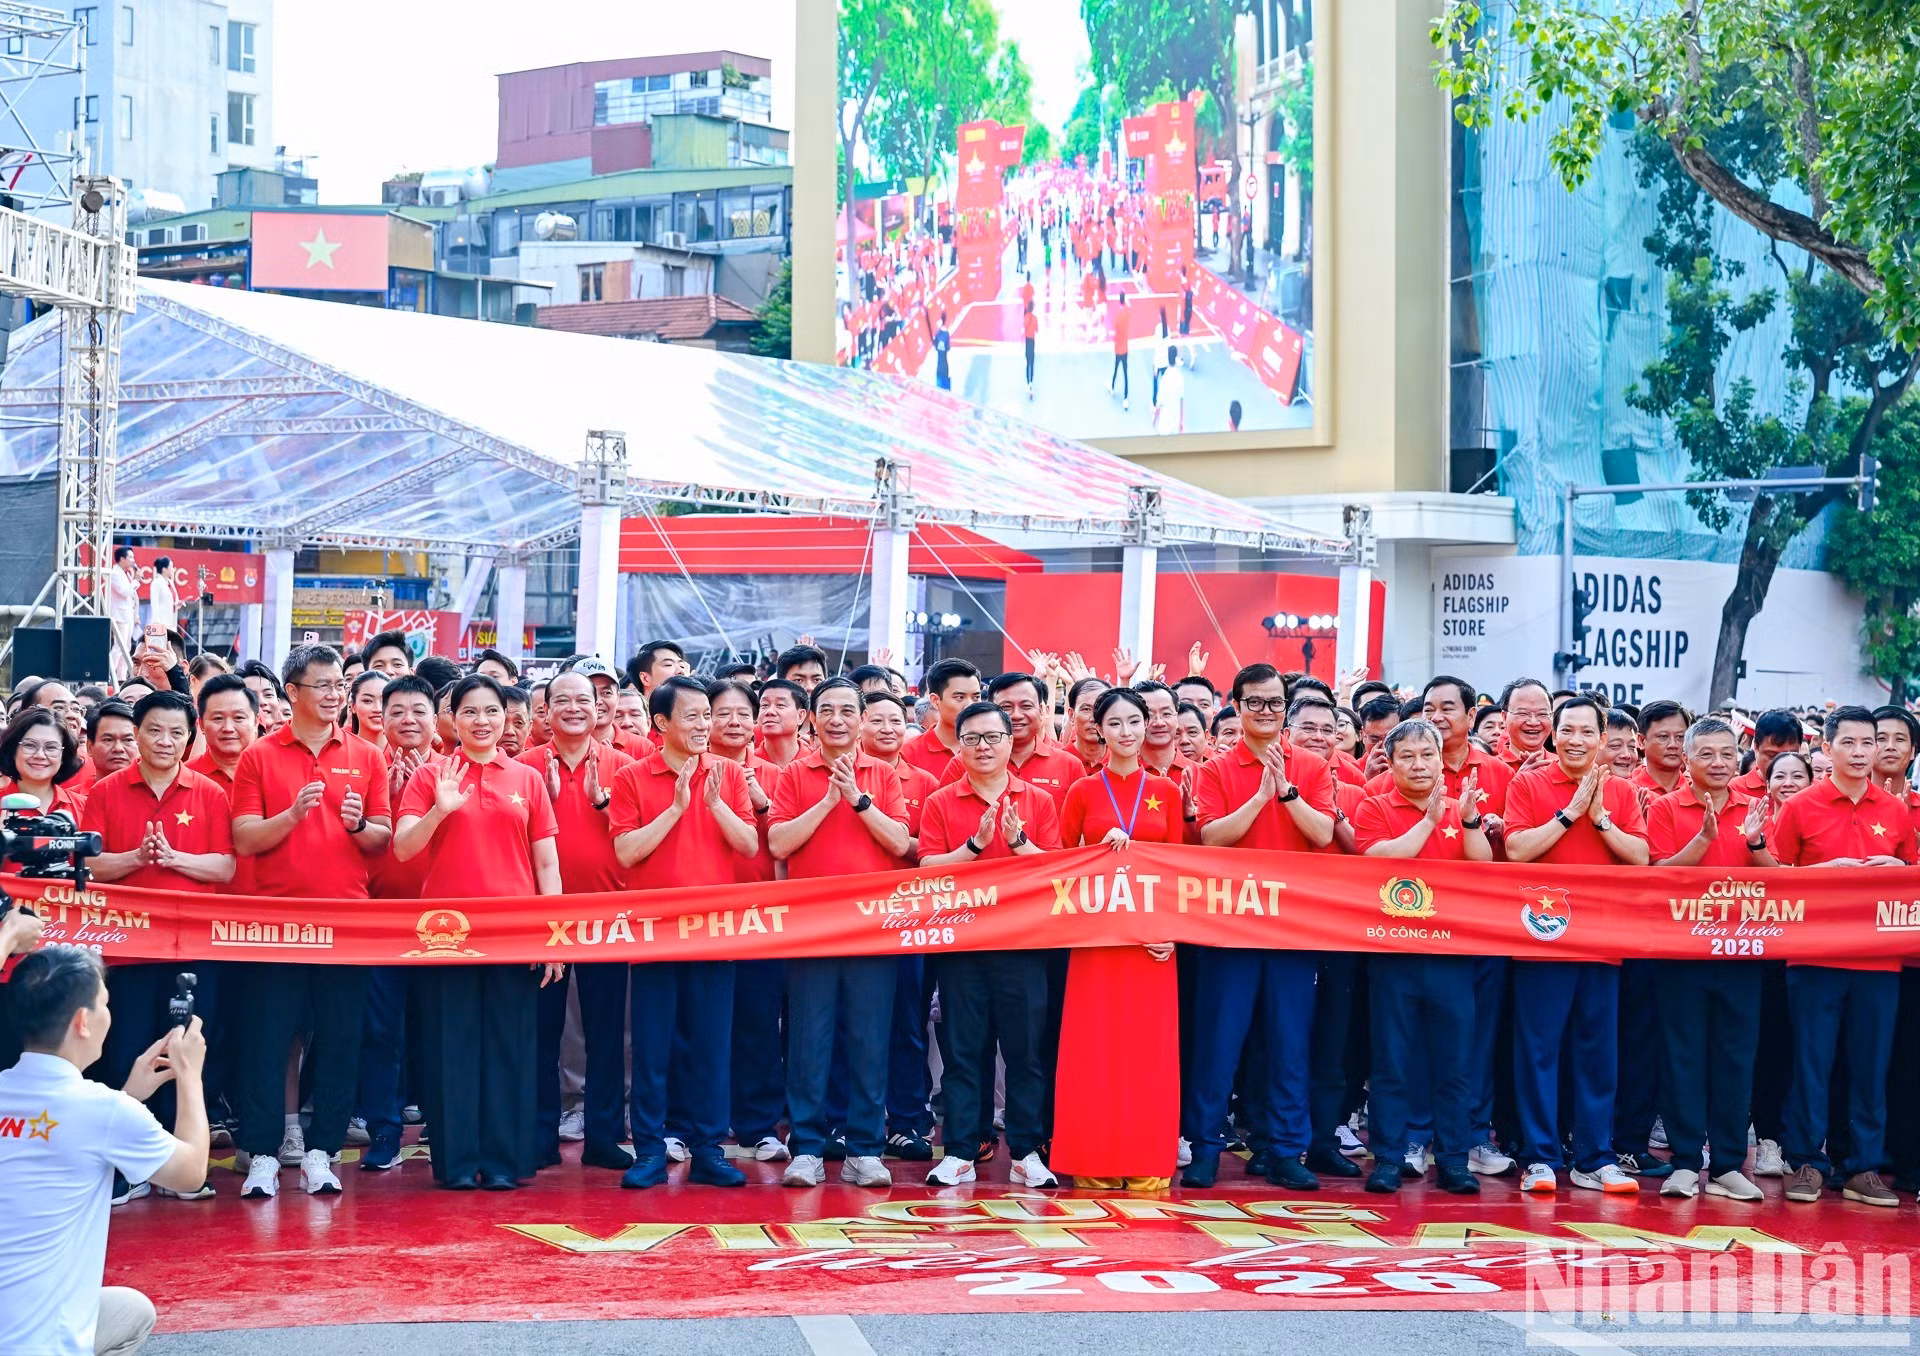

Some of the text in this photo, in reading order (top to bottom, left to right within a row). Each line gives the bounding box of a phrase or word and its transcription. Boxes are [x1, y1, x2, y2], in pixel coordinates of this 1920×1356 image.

[1443, 573, 1495, 591] ADIDAS
[1443, 596, 1510, 613] FLAGSHIP
[1443, 619, 1486, 636] STORE
[1573, 628, 1689, 668] LAGSHIP
[896, 875, 956, 896] CÙNG
[1050, 864, 1287, 917] XUẤT PHÁT
[1708, 876, 1767, 898] CÙNG
[855, 885, 998, 917] VIỆT NAM
[1669, 893, 1805, 926] VIỆT NAM
[80, 906, 151, 930] NAM
[545, 904, 790, 947] XUẤT PHÁT
[881, 905, 977, 930] tiến bước
[1690, 916, 1785, 937] tiến bước
[72, 919, 129, 944] bước
[211, 920, 334, 944] Nhân Dân
[899, 927, 955, 947] 2026
[1366, 925, 1451, 940] BỘ CÔNG AN
[1711, 938, 1765, 956] 2026
[865, 1193, 1391, 1222] CÙNG
[495, 1217, 1820, 1256] VIỆT NAM
[746, 1245, 1132, 1271] tiến
[955, 1271, 1502, 1295] 2026
